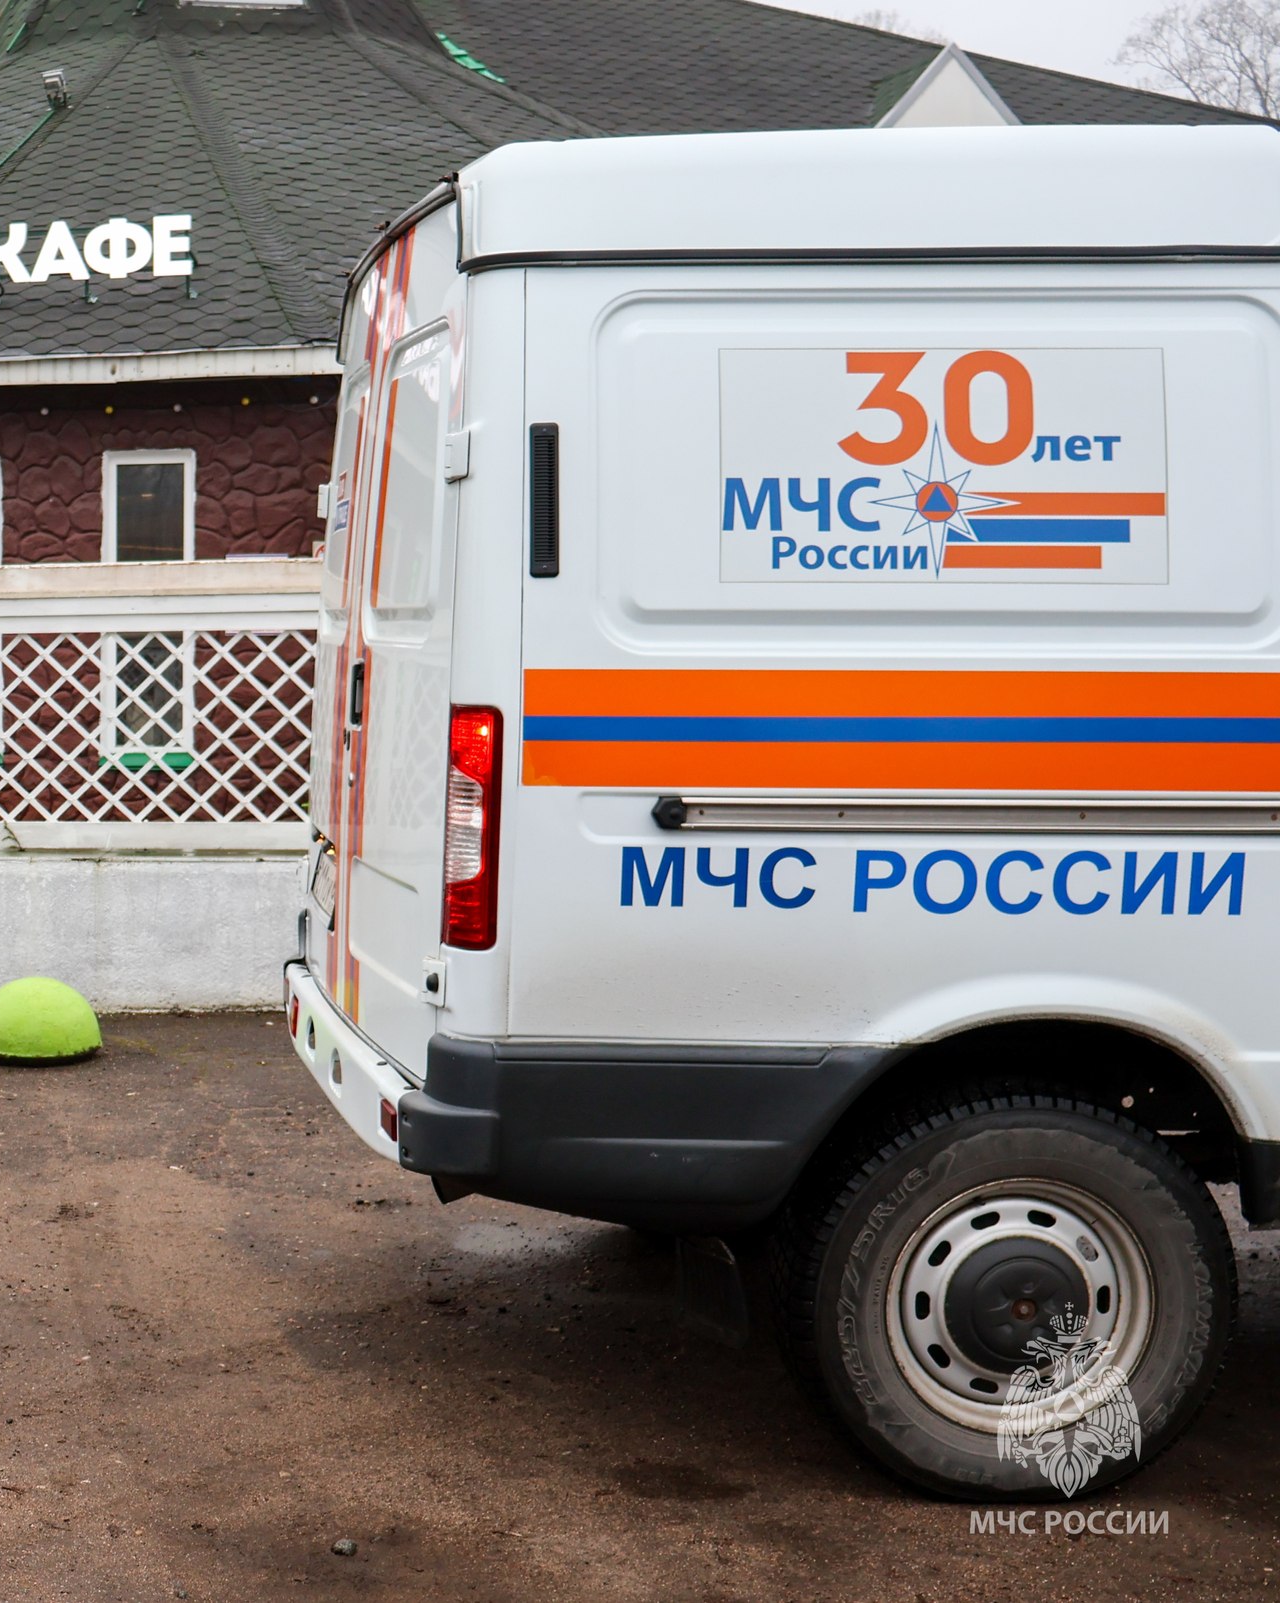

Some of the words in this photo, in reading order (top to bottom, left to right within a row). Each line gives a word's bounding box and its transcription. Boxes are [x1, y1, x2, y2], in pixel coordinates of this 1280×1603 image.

[837, 349, 1035, 466] 30
[1032, 434, 1121, 463] лет
[722, 476, 881, 533] МЧС
[771, 535, 929, 571] России
[619, 846, 817, 910] МЧС
[852, 848, 1248, 917] РОССИИ
